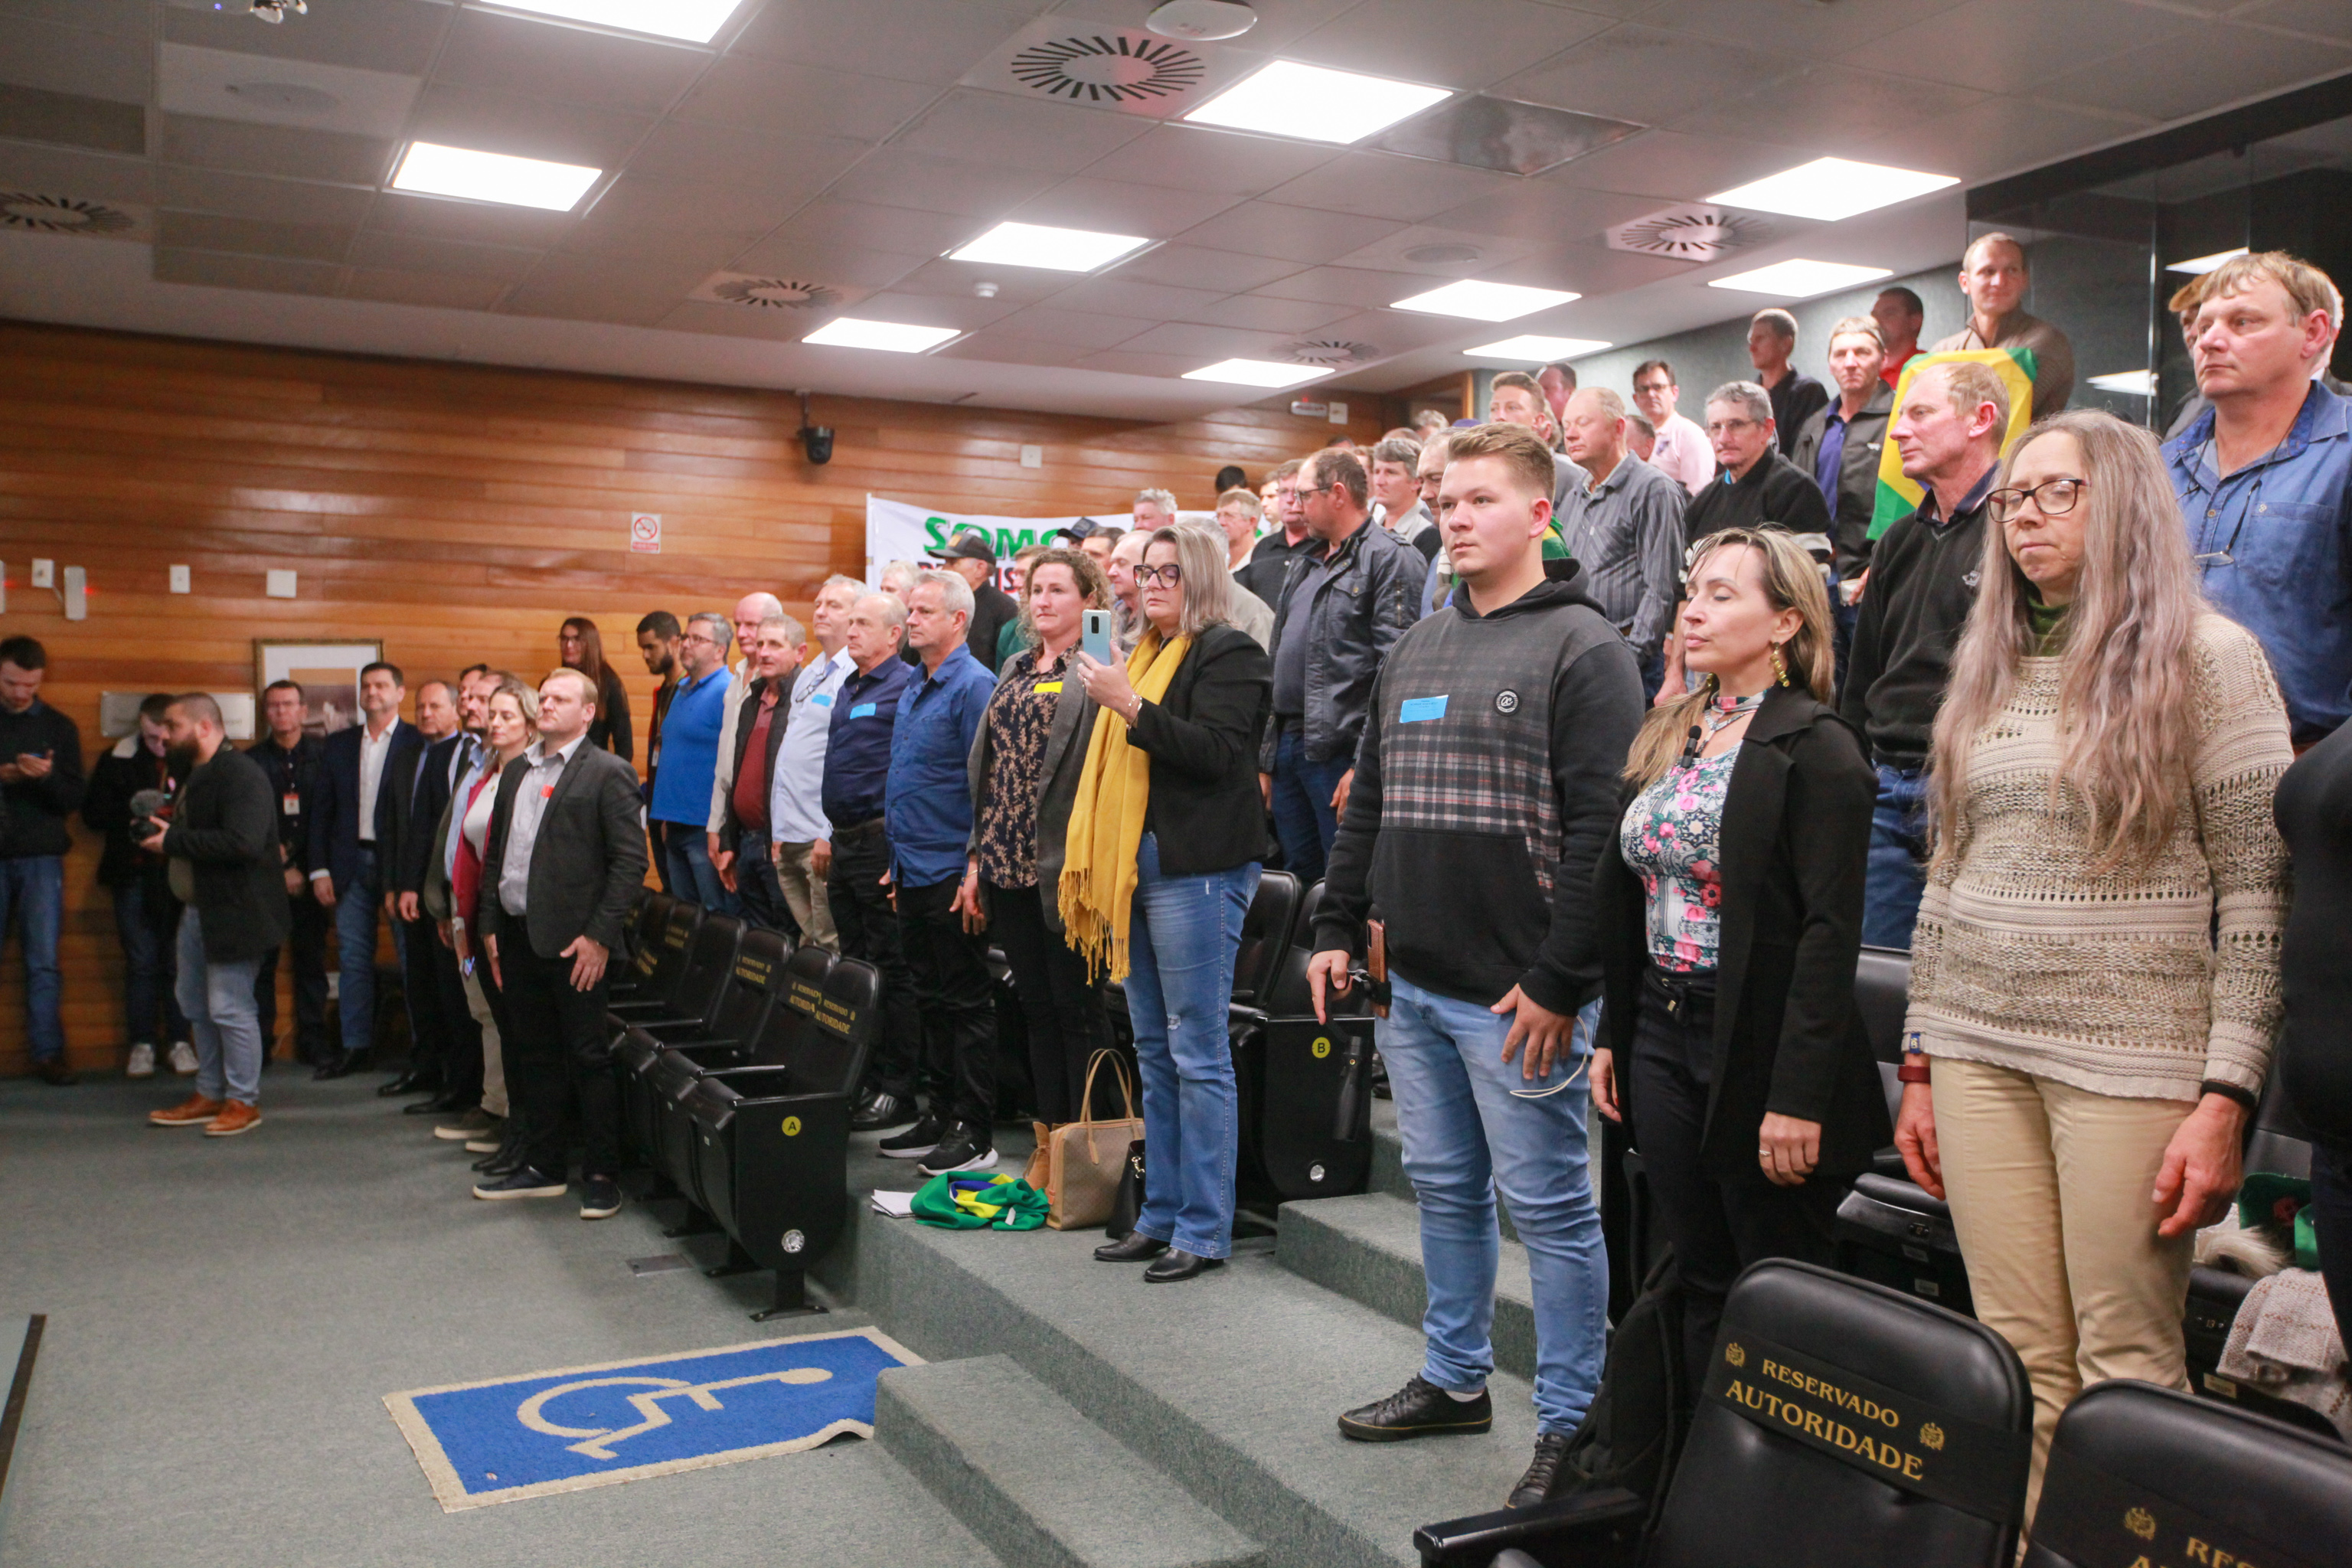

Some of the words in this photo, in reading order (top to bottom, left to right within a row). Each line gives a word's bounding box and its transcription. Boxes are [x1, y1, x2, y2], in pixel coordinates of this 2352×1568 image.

[814, 1010, 851, 1034] AUTORIDADE
[1317, 1042, 1326, 1054] B
[788, 1121, 797, 1132] A
[1762, 1358, 1900, 1429] RESERVADO
[1725, 1379, 1924, 1481] AUTORIDADE
